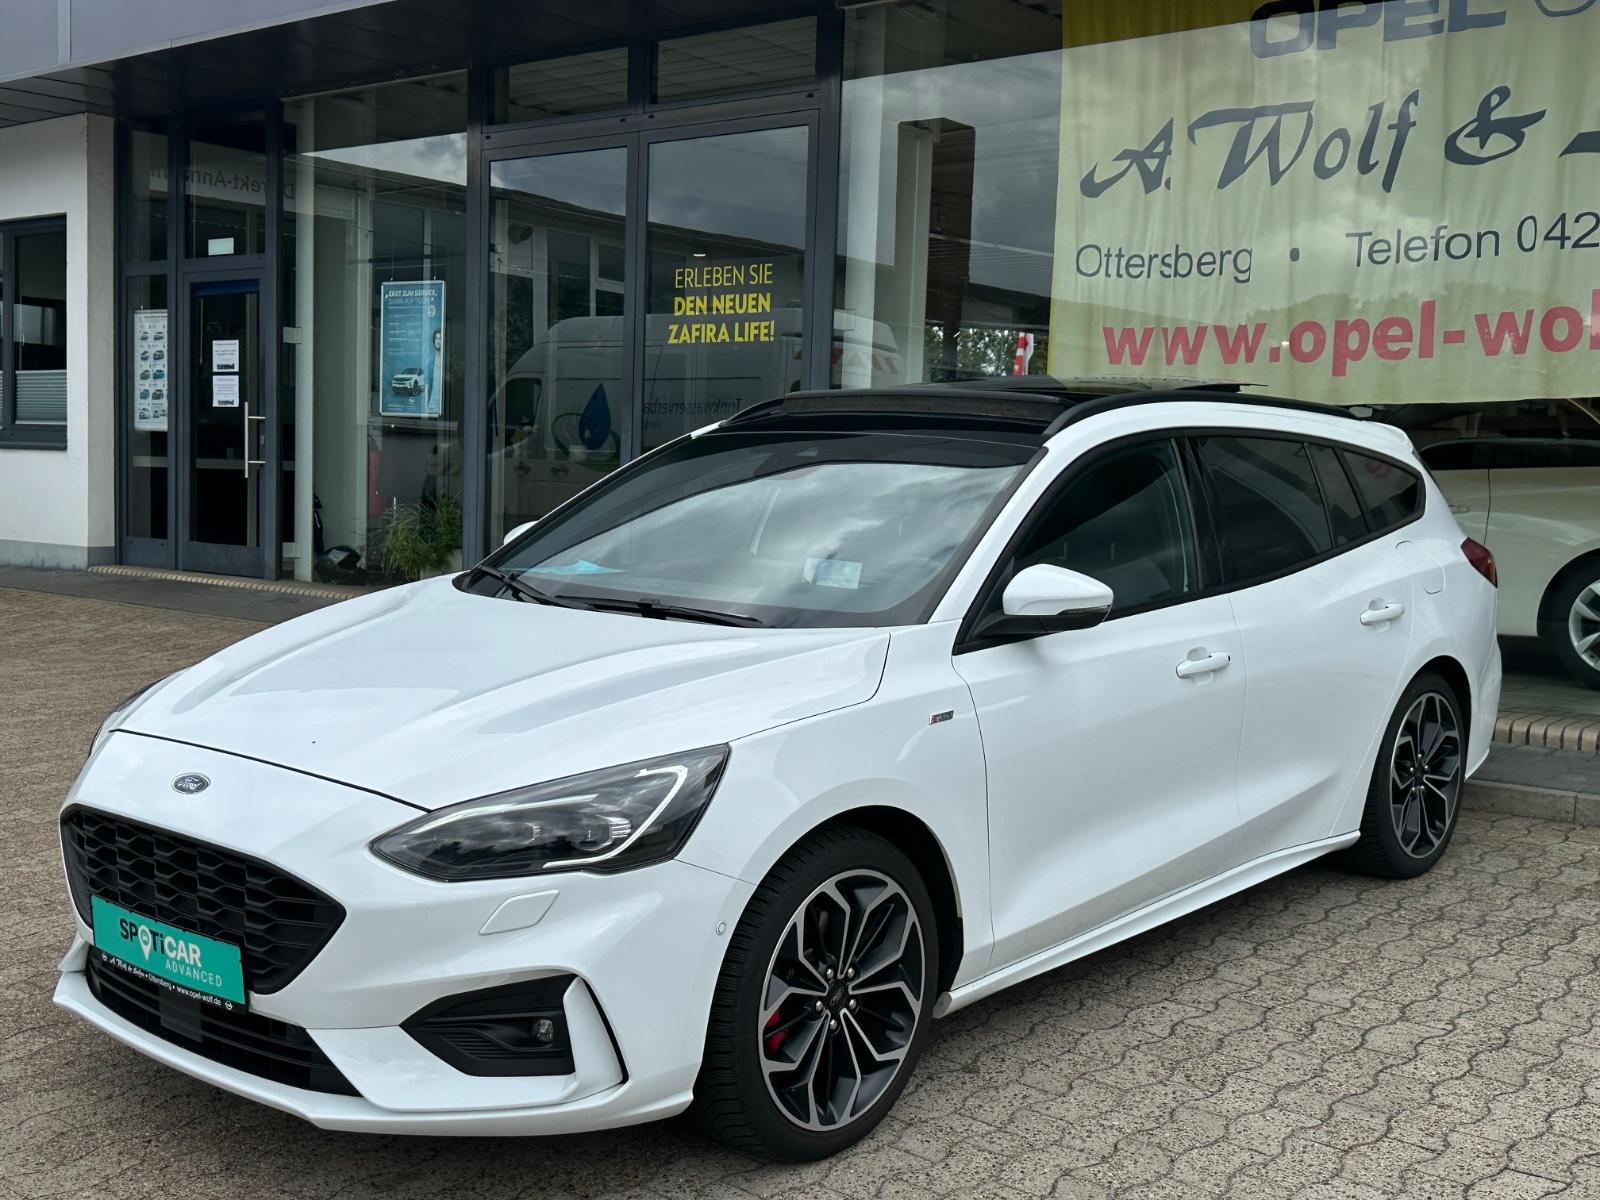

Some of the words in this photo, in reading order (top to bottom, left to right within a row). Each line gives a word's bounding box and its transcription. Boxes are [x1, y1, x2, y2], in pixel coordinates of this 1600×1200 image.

[1250, 0, 1506, 58] OPEL
[1187, 88, 1420, 193] Wolf
[1444, 85, 1547, 165] &
[1076, 243, 1253, 284] Ottersberg
[1345, 225, 1500, 267] Telefon
[1516, 211, 1600, 252] 042
[675, 265, 744, 289] ERLEBEN
[749, 263, 774, 285] SIE
[673, 295, 709, 316] DEN
[712, 292, 771, 315] NEUEN
[667, 322, 731, 344] ZAFIRA
[734, 320, 775, 342] LIFE!
[165, 960, 223, 988] ADVANCED
